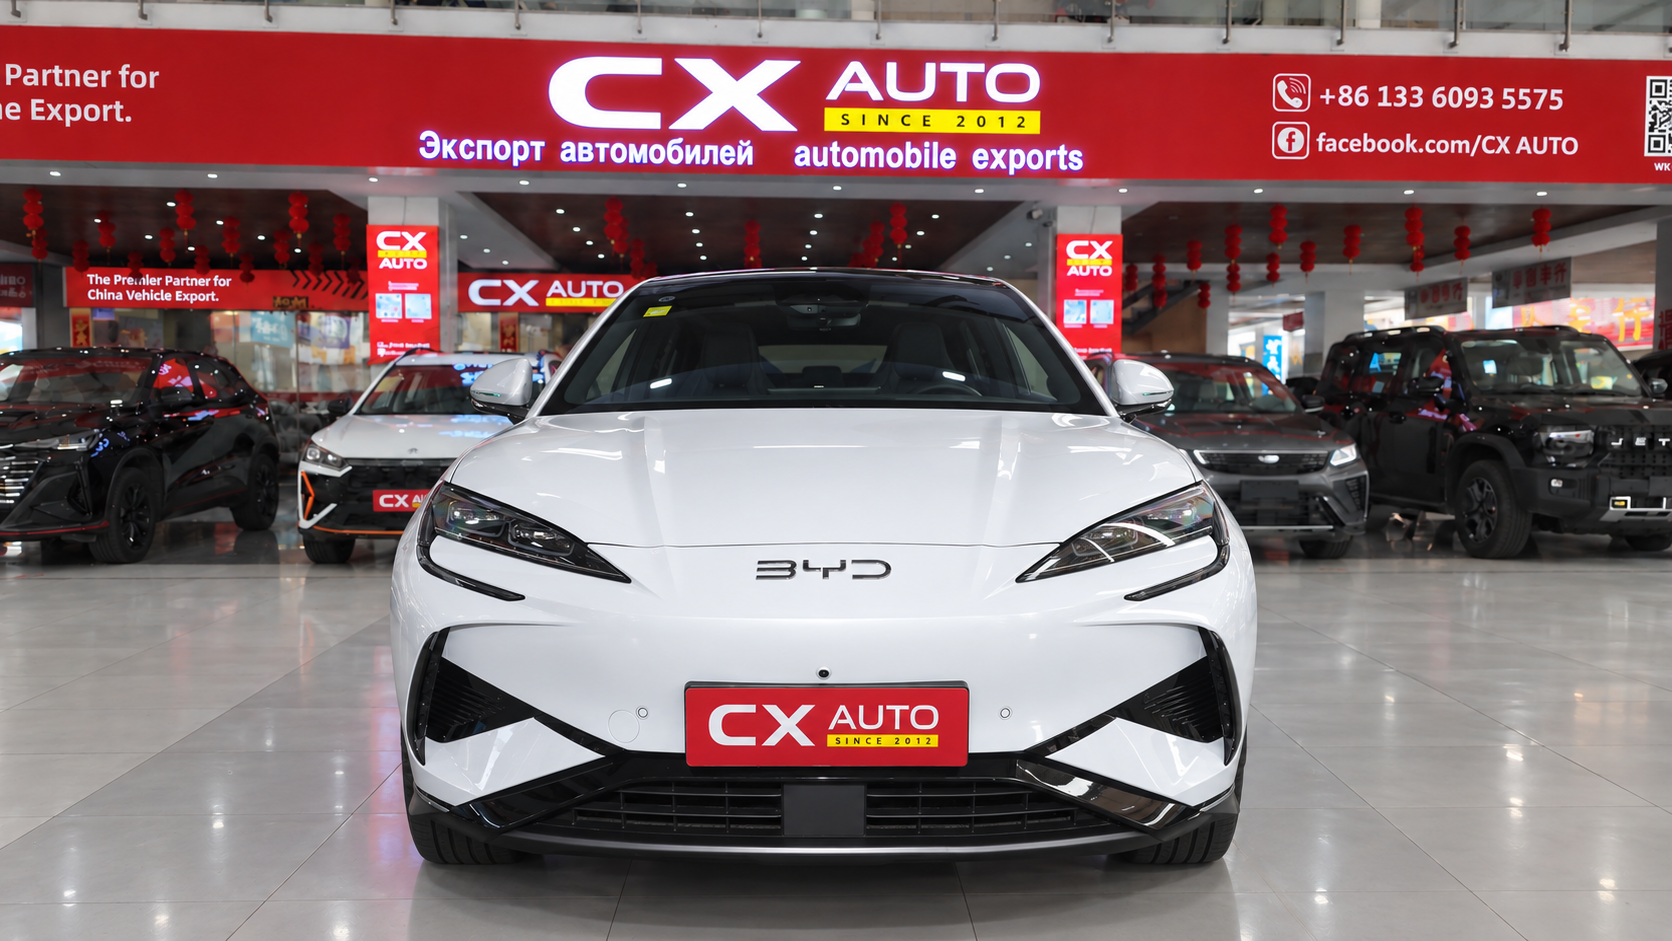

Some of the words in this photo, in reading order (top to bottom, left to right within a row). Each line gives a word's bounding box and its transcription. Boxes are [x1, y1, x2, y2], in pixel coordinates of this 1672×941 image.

[5, 63, 112, 88] Partner
[118, 64, 160, 89] for
[549, 56, 801, 131] CX
[825, 61, 1041, 103] AUTO
[1319, 85, 1370, 107] +86
[1377, 85, 1424, 108] 133
[1432, 86, 1494, 109] 6093
[1502, 88, 1564, 111] 5575
[30, 98, 132, 127] Export.
[841, 113, 932, 127] SINCE
[956, 116, 1026, 129] 2012
[419, 130, 545, 167] Экспорт
[560, 138, 754, 165] автомобилей
[1316, 132, 1510, 157] facebook.com/CX
[1515, 136, 1579, 155] AUTO
[794, 141, 957, 169] automobile
[972, 144, 1084, 176] exports
[376, 231, 427, 251] CX
[1066, 240, 1113, 260] CX
[379, 258, 428, 269] AUTO
[1066, 265, 1113, 277] AUTO
[87, 274, 111, 285] The
[114, 273, 163, 286] Premier
[165, 276, 211, 287] Partner
[213, 275, 232, 287] for
[87, 288, 123, 300] China
[125, 288, 172, 301] Vehicle
[175, 291, 219, 304] Export.
[468, 279, 539, 307] CX
[547, 280, 624, 298] AUTO
[379, 494, 409, 508] CX
[756, 559, 892, 580] BYD
[708, 704, 816, 747] CX
[828, 705, 940, 730] AUTO
[835, 737, 882, 745] SINCE
[894, 737, 932, 745] 2012
